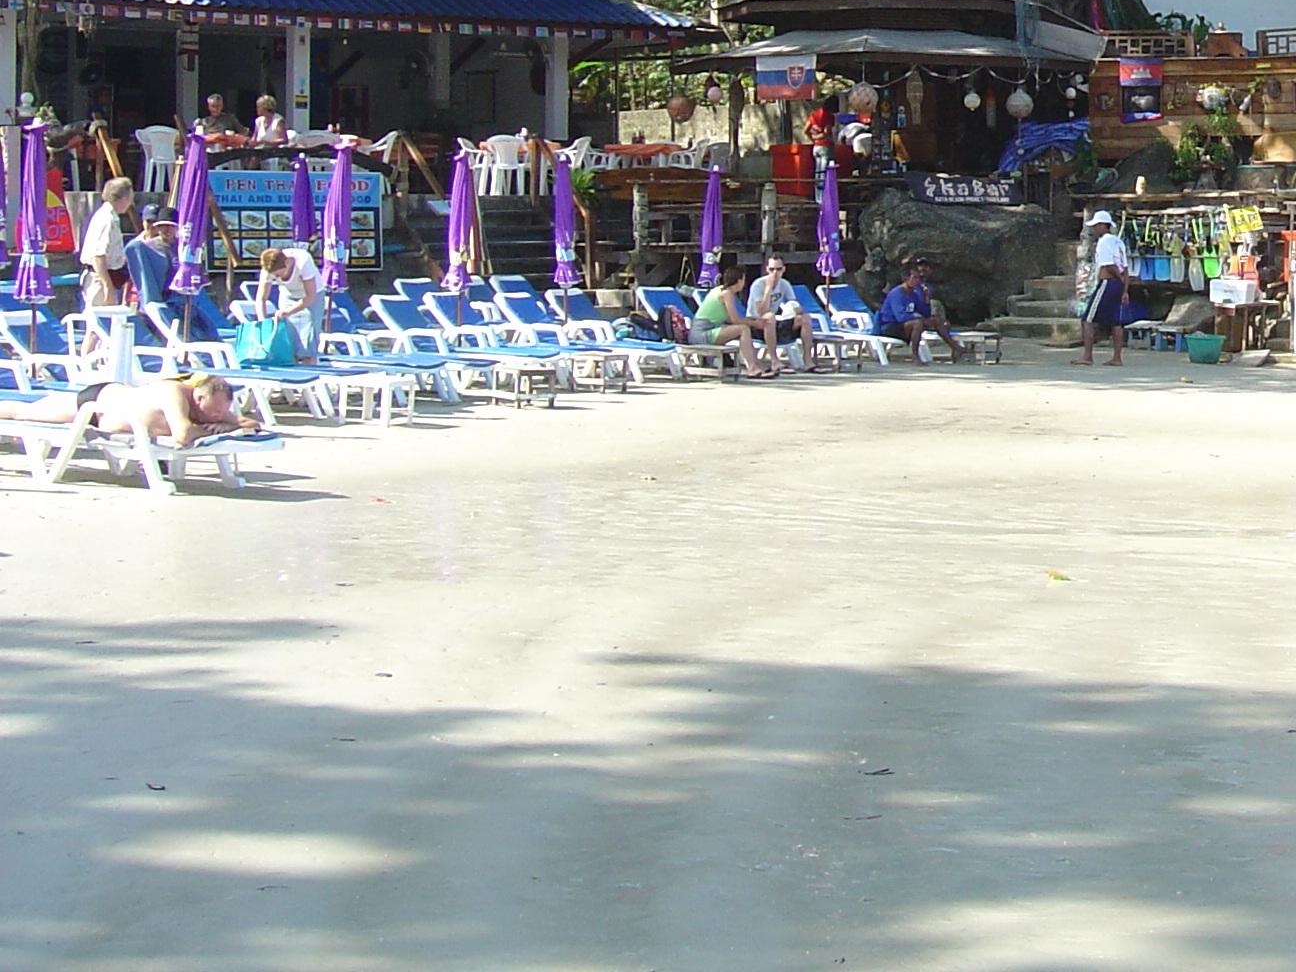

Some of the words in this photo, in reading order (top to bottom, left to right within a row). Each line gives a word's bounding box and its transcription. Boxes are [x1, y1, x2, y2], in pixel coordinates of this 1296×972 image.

[225, 179, 256, 191] PEN
[264, 179, 295, 192] THA
[214, 194, 242, 203] THAI
[248, 195, 272, 203] AND
